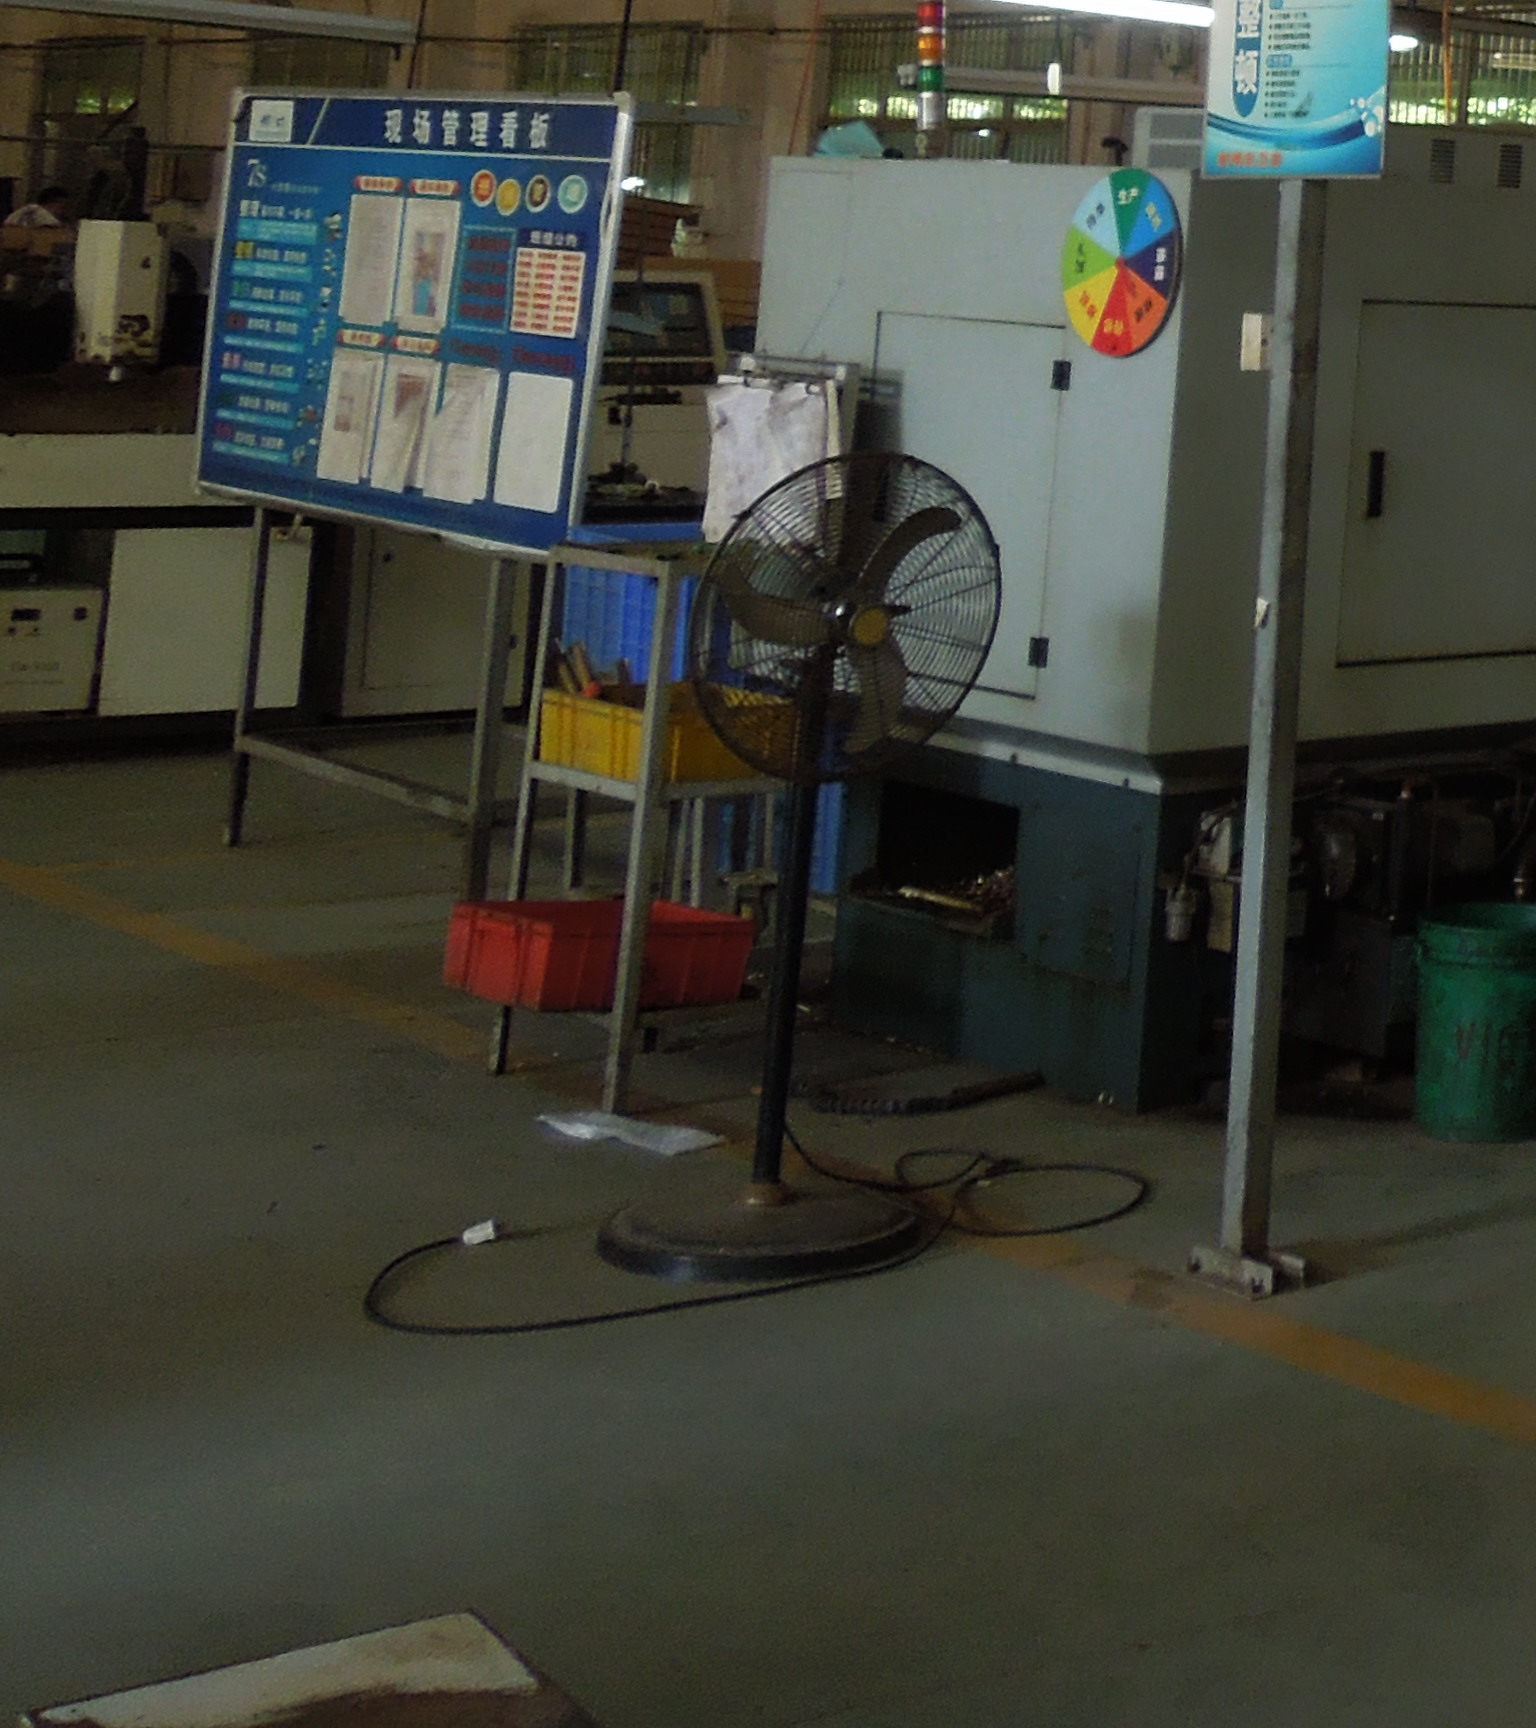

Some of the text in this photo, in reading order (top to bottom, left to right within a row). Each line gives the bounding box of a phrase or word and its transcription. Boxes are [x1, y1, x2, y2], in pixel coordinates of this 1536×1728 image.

[384, 108, 550, 149] 现场管理看板
